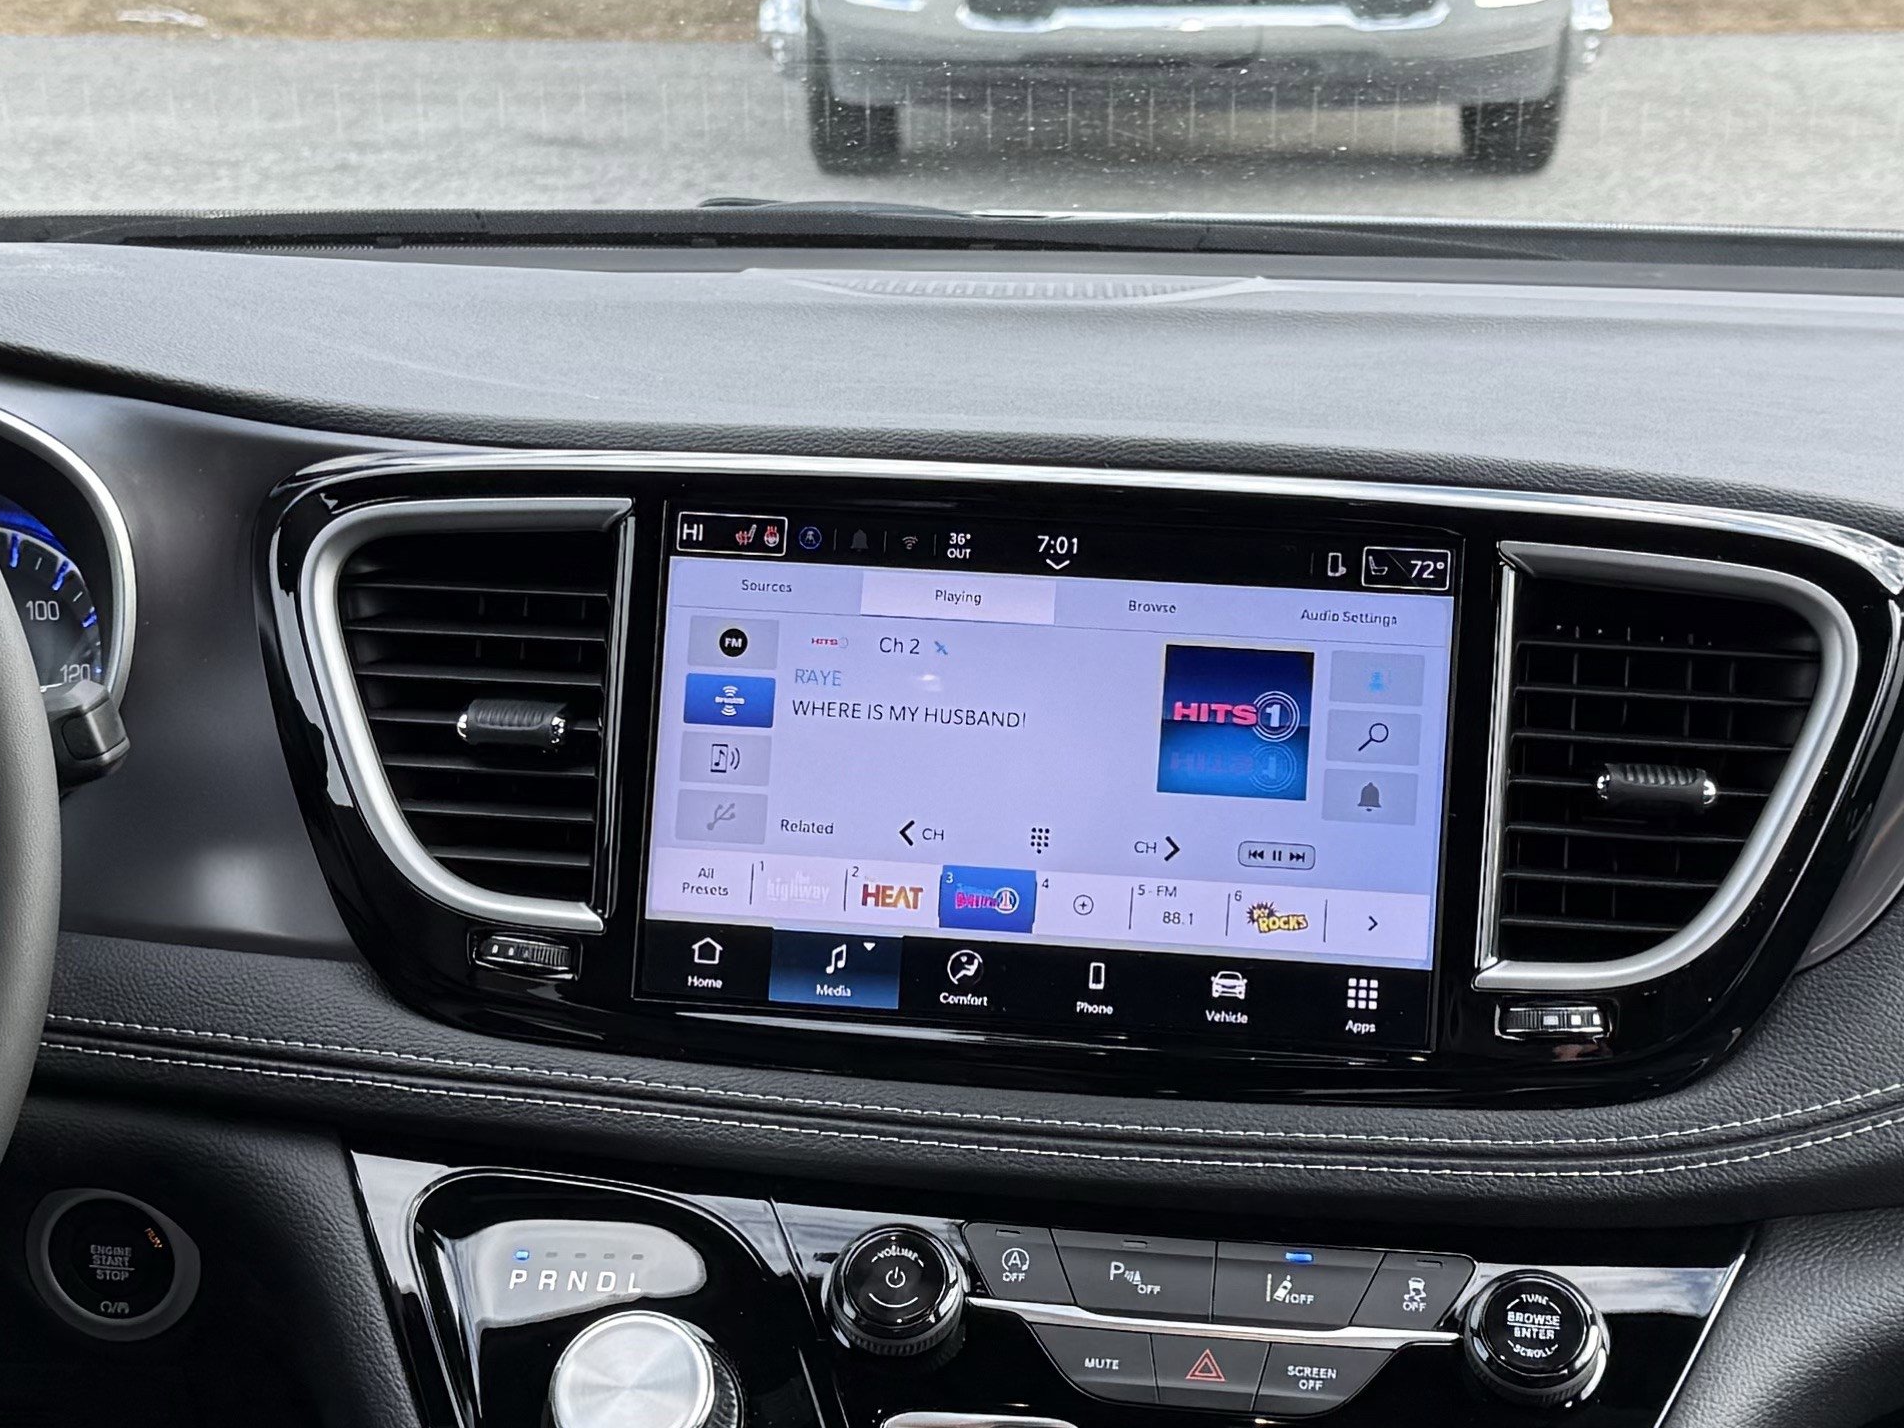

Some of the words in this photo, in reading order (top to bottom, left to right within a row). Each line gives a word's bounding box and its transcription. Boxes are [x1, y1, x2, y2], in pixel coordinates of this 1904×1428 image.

[682, 523, 704, 542] HI
[947, 547, 972, 560] OUT
[1037, 535, 1079, 556] 7:01
[1410, 559, 1446, 580] 72°
[741, 578, 793, 594] Sources
[934, 589, 983, 607] Playing
[26, 600, 60, 621] 100
[1128, 599, 1177, 614] Browse
[1300, 608, 1340, 623] Audio
[1342, 611, 1398, 628] Settings
[724, 637, 743, 649] FM
[879, 636, 904, 654] Ch
[909, 638, 921, 655] 2
[60, 663, 91, 683] 120
[795, 668, 843, 687] RAYE
[792, 699, 862, 721] WHERE
[866, 703, 884, 721] IS
[889, 704, 921, 723] MY
[924, 708, 1027, 729] HUSBAND!
[780, 818, 835, 836] Related
[922, 828, 945, 842] CH
[1133, 840, 1158, 855] CH
[851, 866, 860, 878] 2
[945, 872, 954, 884] 3
[682, 882, 730, 898] Presets
[1042, 878, 1050, 889] 4
[861, 883, 924, 910] HEAT
[1234, 890, 1243, 902] 6
[1162, 910, 1194, 926] 88.1
[688, 975, 723, 990] Home
[816, 983, 852, 998] Media
[939, 991, 989, 1008] Comfort
[1076, 1000, 1114, 1016] Phone
[1205, 1009, 1249, 1025] Vehicle
[1345, 1019, 1377, 1035] Apps
[92, 1255, 130, 1267] START
[96, 1269, 130, 1281] STOP
[1002, 1271, 1026, 1282] OFF
[1137, 1284, 1162, 1296] OFF
[1290, 1293, 1315, 1305] OFF
[1402, 1300, 1427, 1313] OFF
[1506, 1310, 1562, 1327] BROWSE
[1513, 1326, 1556, 1341] ENTER
[1084, 1357, 1120, 1371] MUTE
[1286, 1364, 1338, 1380] SCREEN
[1298, 1379, 1324, 1391] OFF
